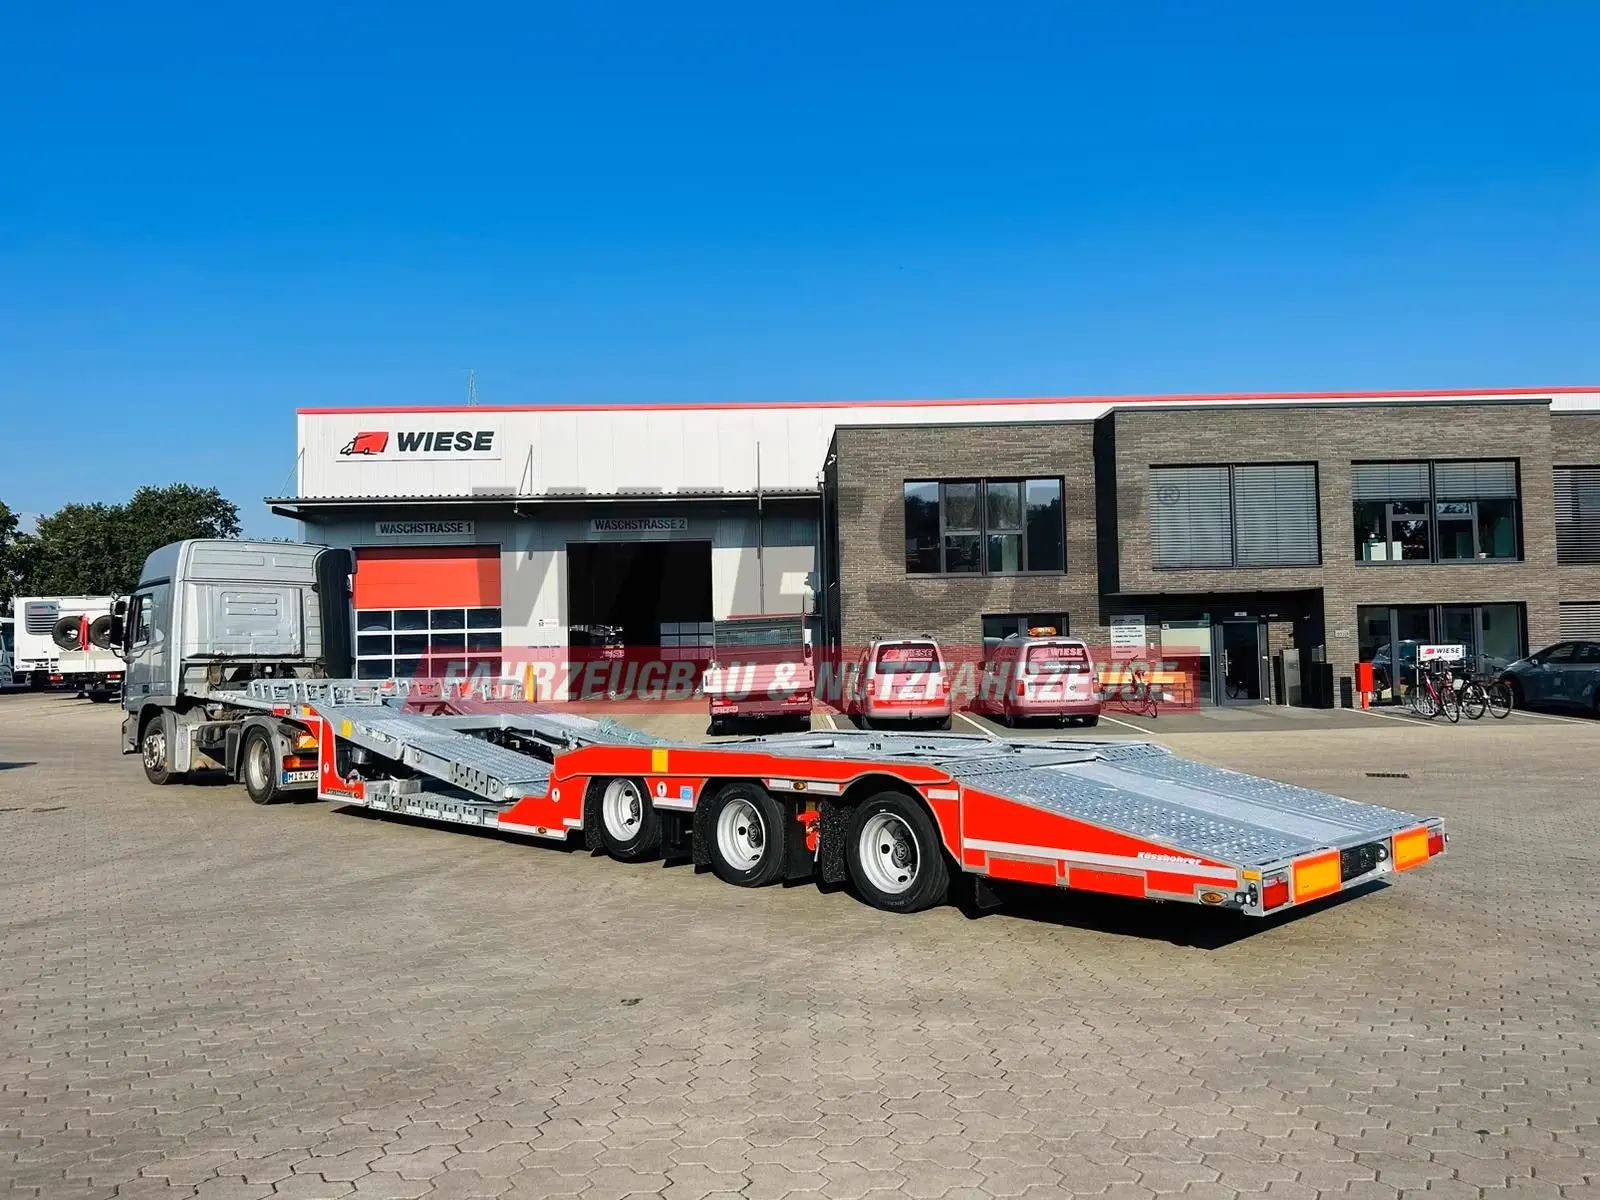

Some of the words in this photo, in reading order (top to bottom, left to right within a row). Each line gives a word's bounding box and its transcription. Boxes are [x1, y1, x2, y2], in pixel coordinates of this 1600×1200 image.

[397, 431, 494, 452] WIESE
[380, 522, 464, 534] WASCHSTRASSE
[466, 522, 471, 532] 1
[595, 519, 677, 531] WASCHSTRASSE
[679, 519, 685, 529] 2
[1050, 647, 1083, 657] WIESE
